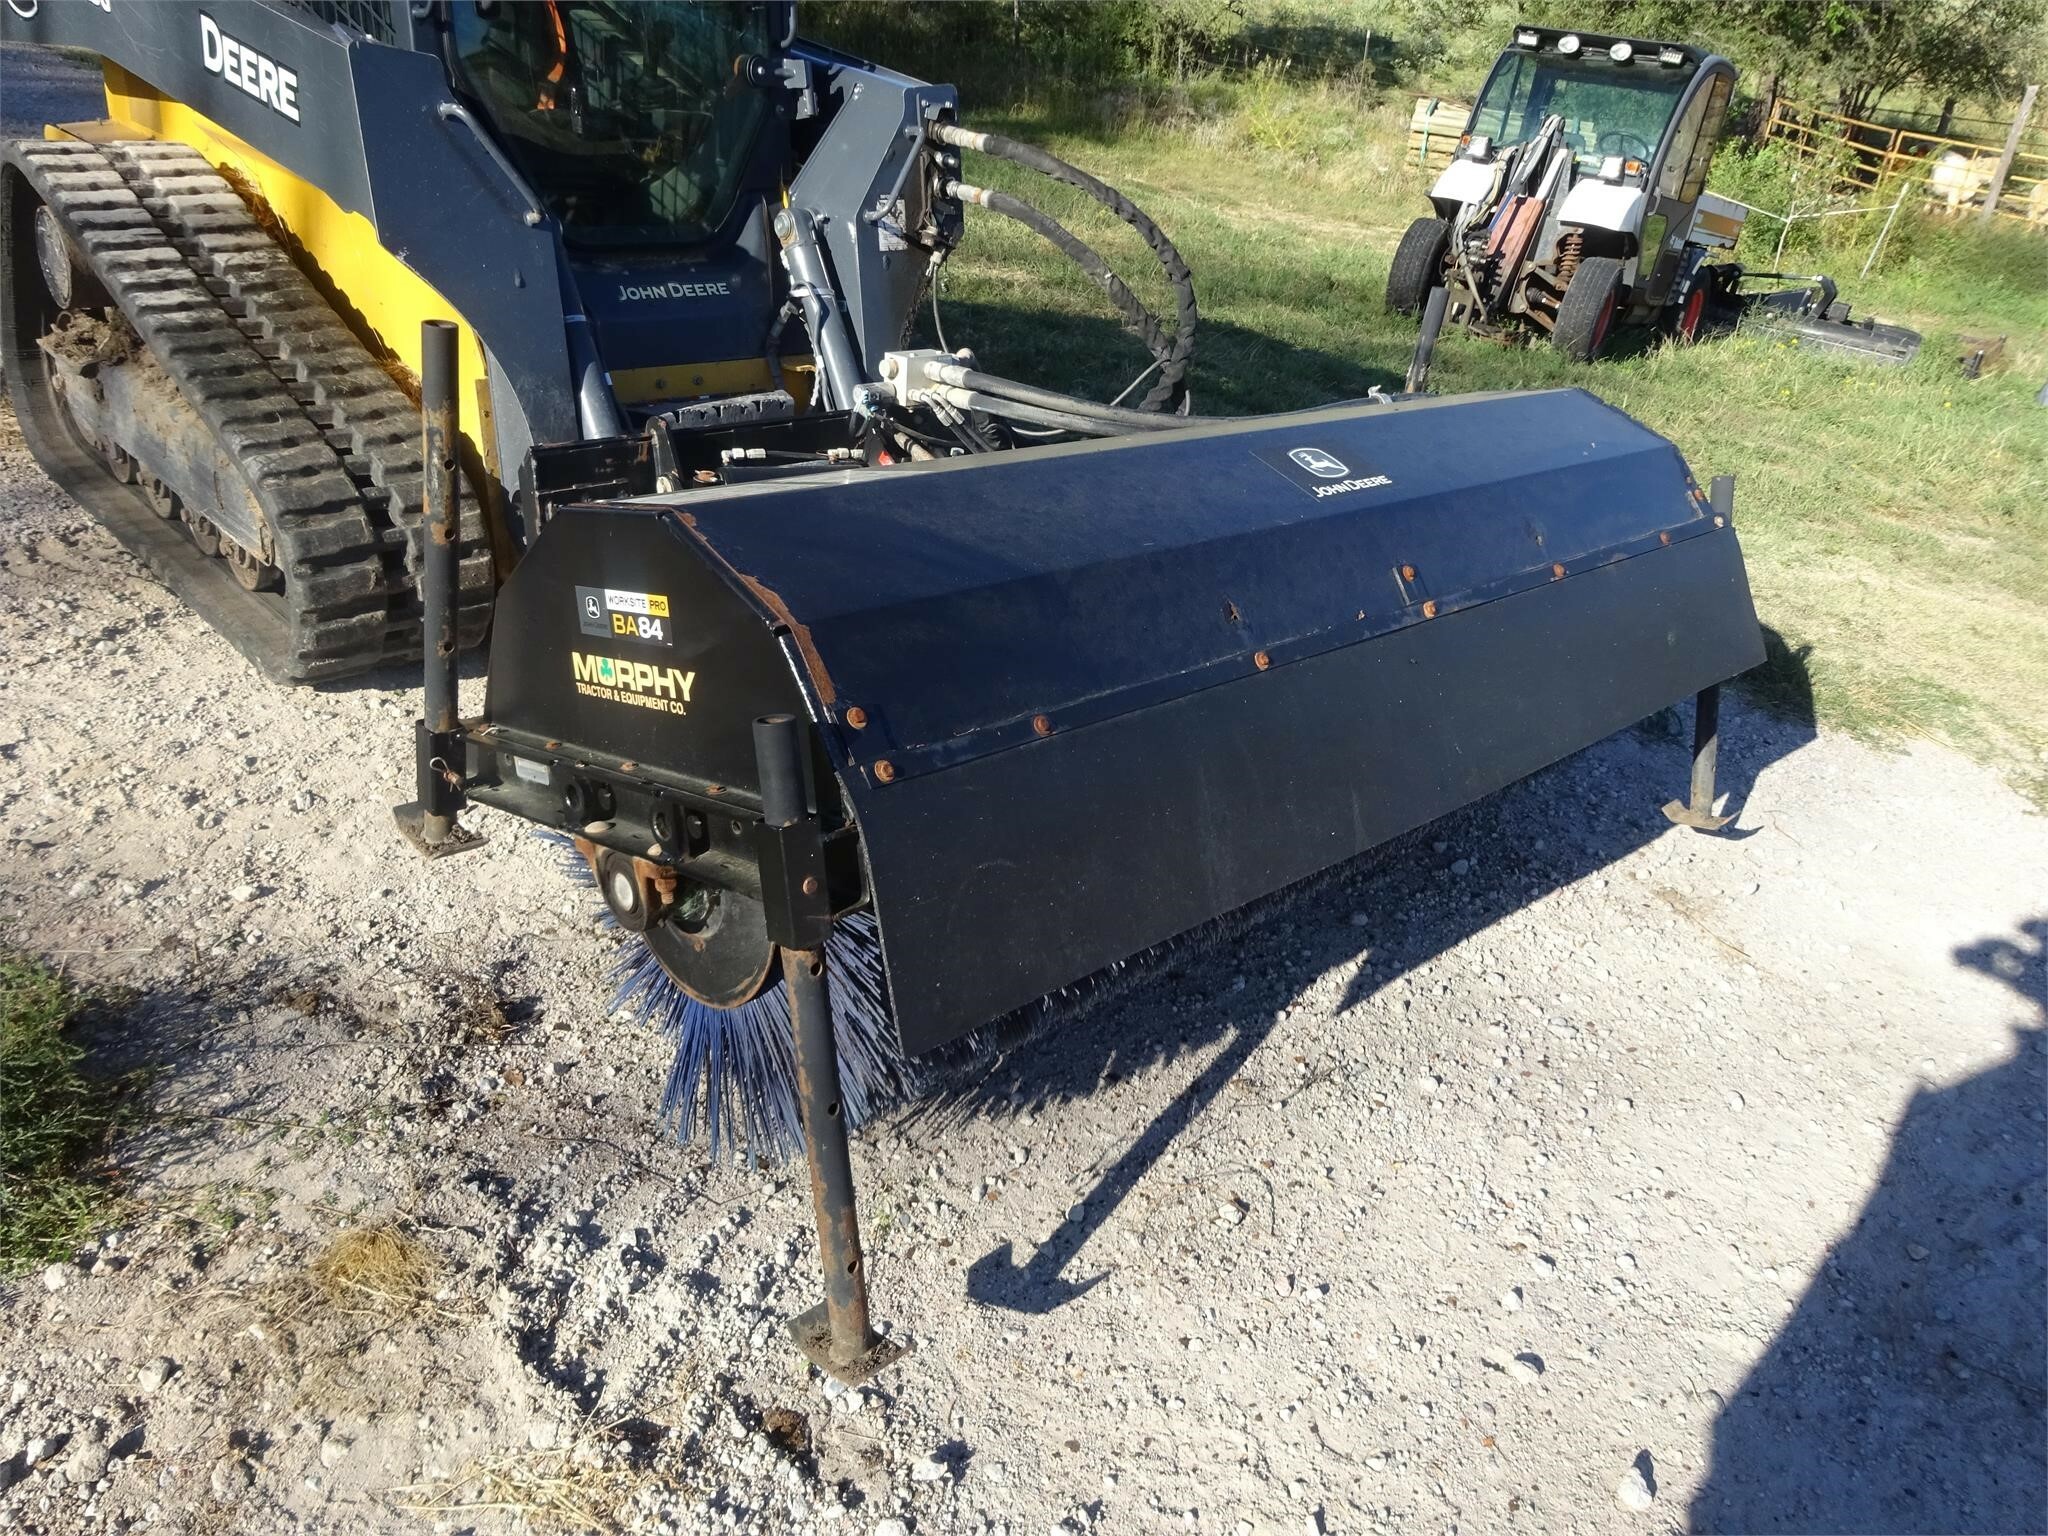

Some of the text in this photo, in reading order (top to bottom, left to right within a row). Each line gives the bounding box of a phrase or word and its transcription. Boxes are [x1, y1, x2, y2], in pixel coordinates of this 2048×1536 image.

[200, 13, 300, 122] DEERE
[619, 282, 730, 301] JOHN DEERE
[1312, 475, 1393, 498] JOHN DEERE
[608, 595, 667, 612] WORKSITE PRO
[612, 613, 664, 641] BA84
[571, 651, 696, 702] MURPHY
[576, 682, 687, 716] TRACTOR & EQUIPMENT CO.
